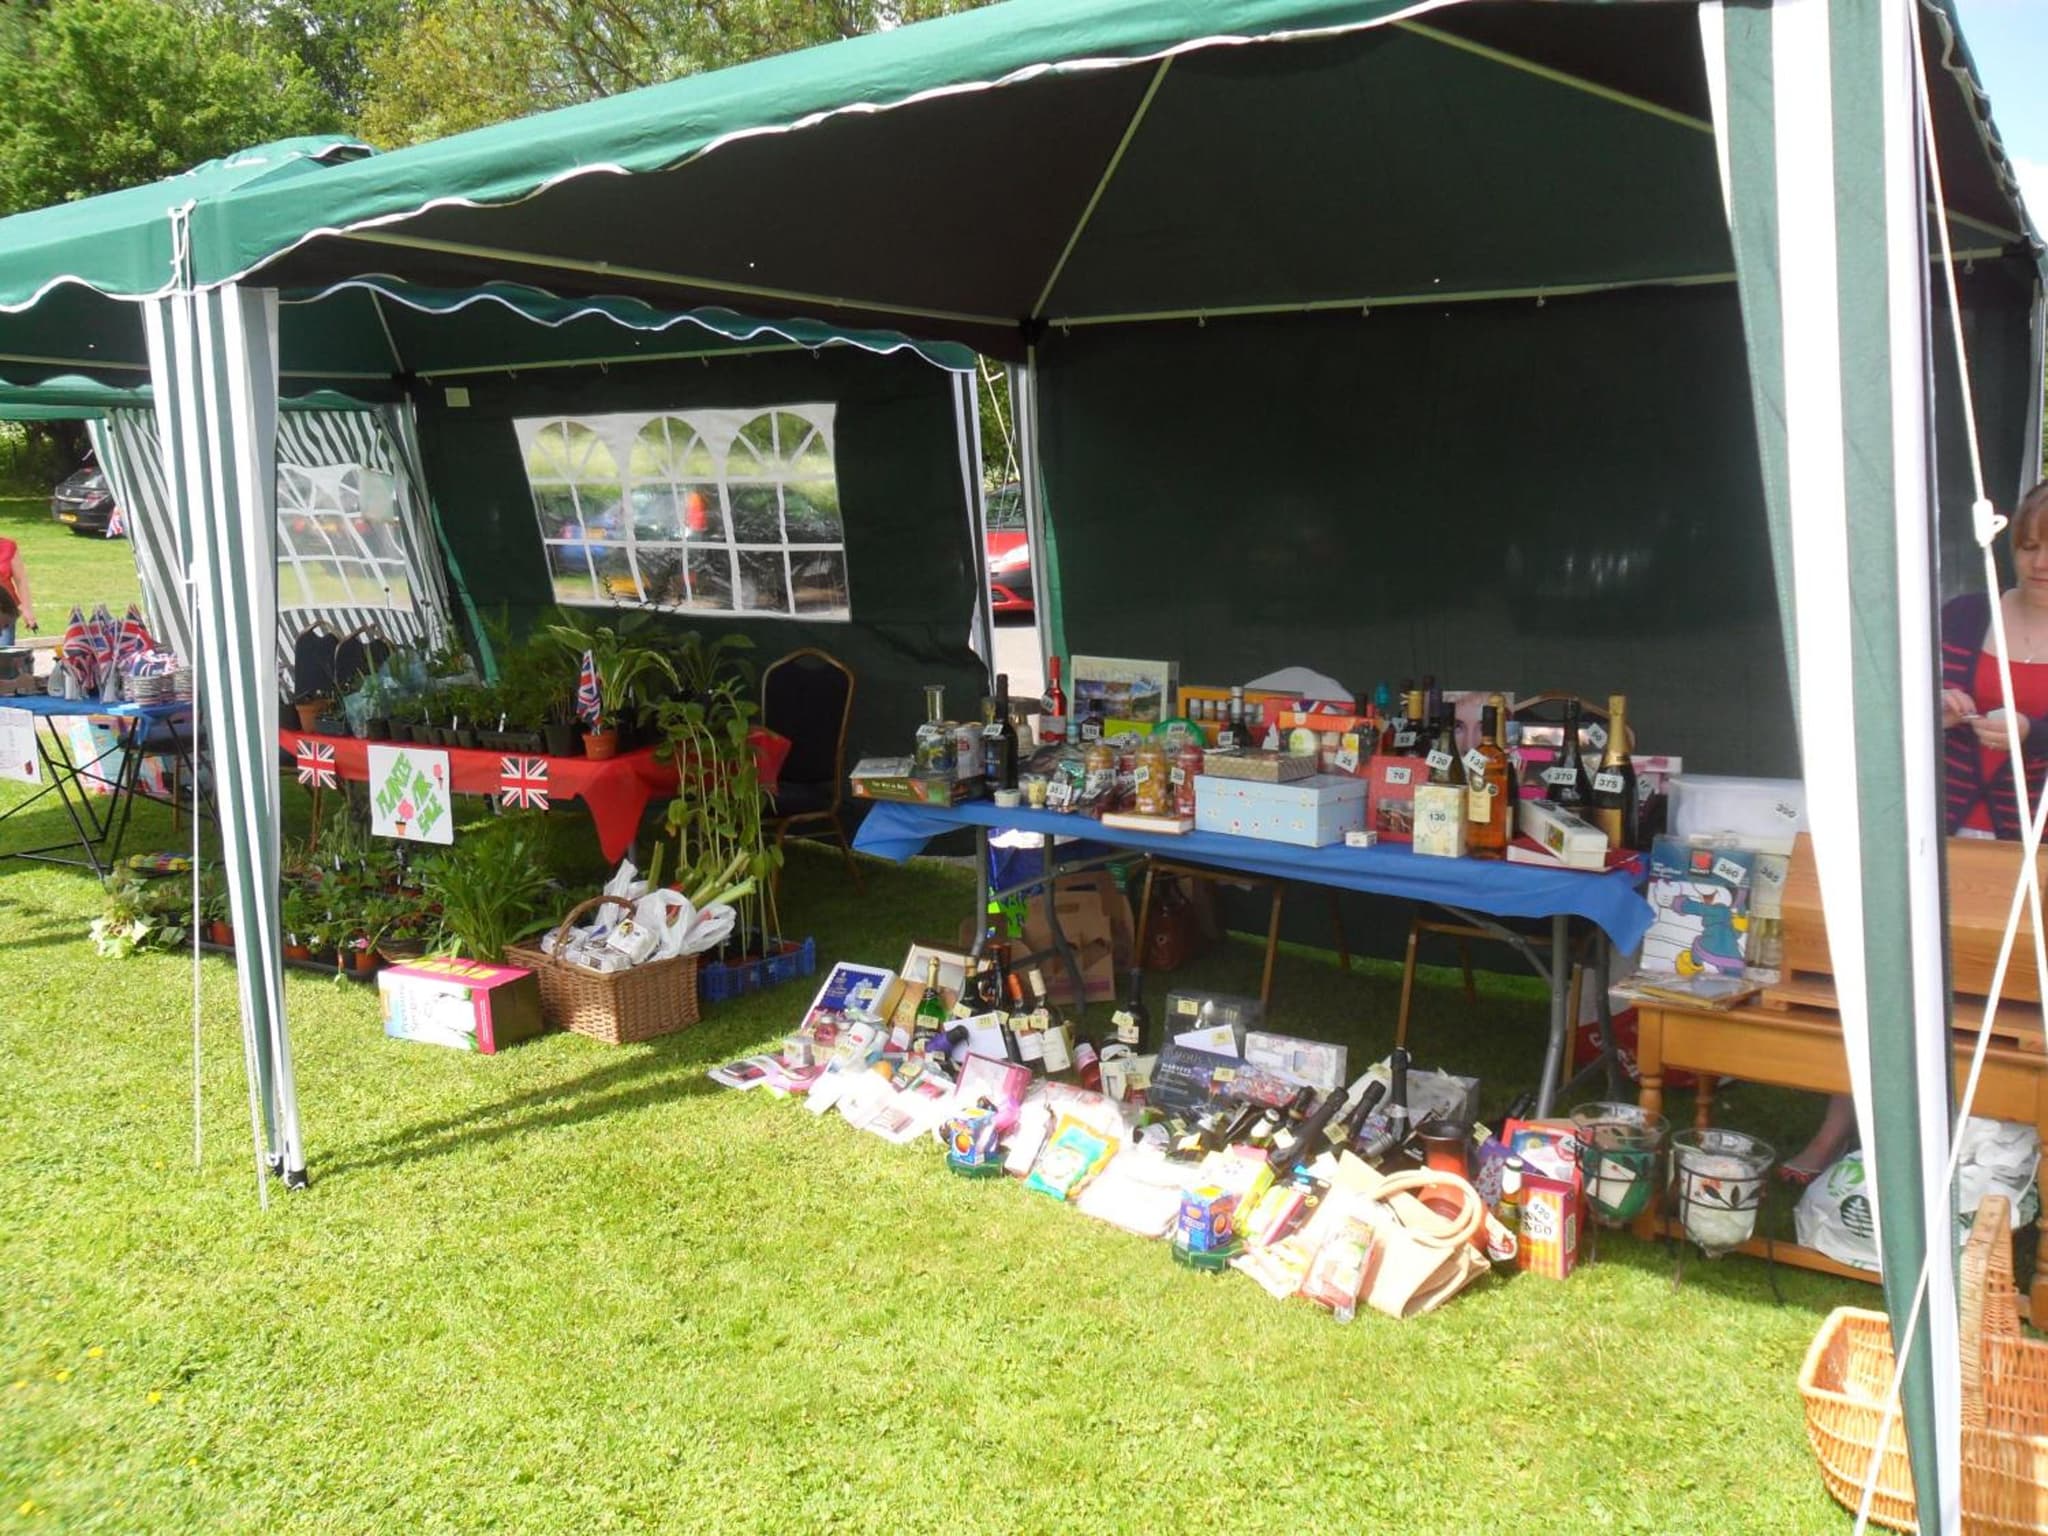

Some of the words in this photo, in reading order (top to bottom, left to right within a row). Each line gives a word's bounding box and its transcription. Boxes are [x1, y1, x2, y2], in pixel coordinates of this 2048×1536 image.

[1431, 755, 1448, 767] 120
[1599, 778, 1618, 789] 375
[1428, 812, 1446, 823] 130
